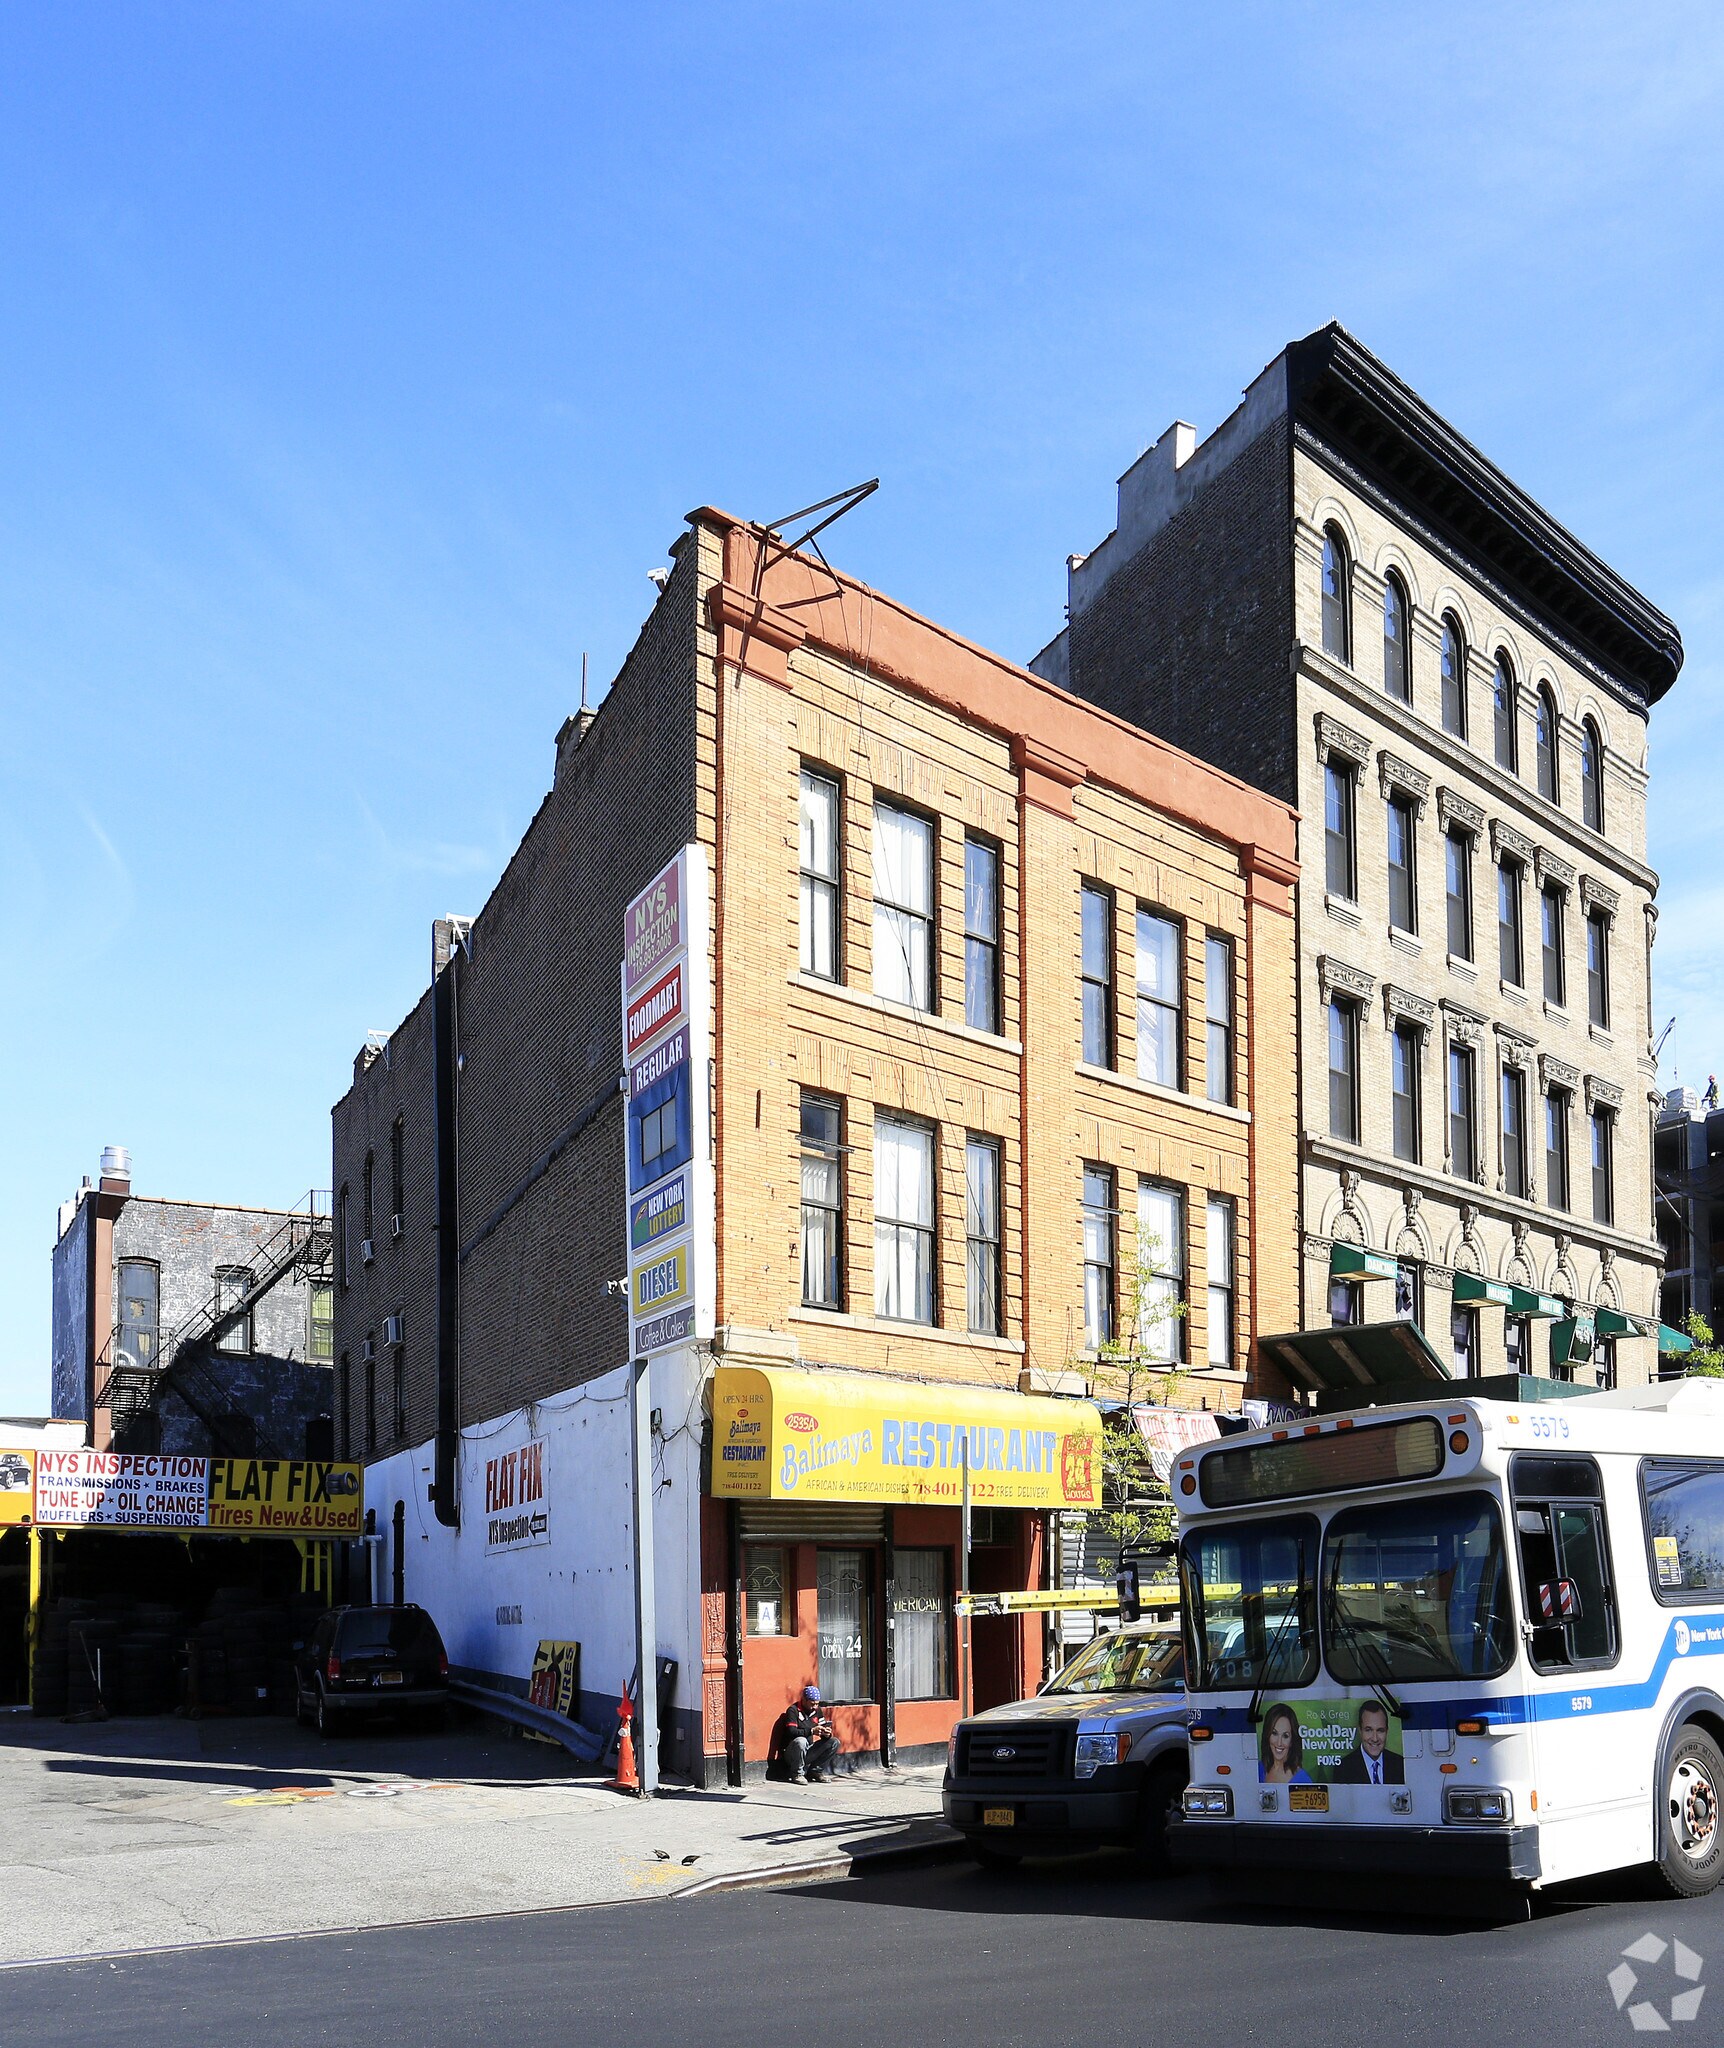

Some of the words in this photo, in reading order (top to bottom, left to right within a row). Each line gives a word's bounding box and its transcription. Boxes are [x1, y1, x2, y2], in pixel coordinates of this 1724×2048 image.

[635, 881, 667, 937] NYS
[627, 902, 678, 967] INSPECTION
[629, 976, 679, 1043] FOODMART
[636, 1035, 683, 1093] REGULAR
[648, 1194, 664, 1218] NEW
[664, 1180, 684, 1211] YORK
[649, 1205, 684, 1237] LOTTERY
[639, 1256, 680, 1307] DIESEL
[1488, 1286, 1511, 1303] MUSIC
[722, 1395, 740, 1404] OPEN
[741, 1395, 748, 1404] 24
[729, 1419, 761, 1438] Balimaya
[787, 1414, 815, 1431] 2535A
[1530, 1416, 1570, 1439] 5579
[722, 1445, 766, 1461] RESTAURANT
[780, 1428, 873, 1490] Balimaya
[882, 1419, 1056, 1473] RESTAURANT
[39, 1453, 79, 1473] NYS
[86, 1454, 207, 1478] INSPECTION
[40, 1475, 141, 1490] TRANSMISSIONS
[155, 1480, 205, 1493] BRAKES
[208, 1459, 280, 1501] FLAT
[287, 1462, 334, 1503] FIX
[485, 1451, 517, 1514] FLAT
[519, 1442, 543, 1504] FIX
[806, 1479, 838, 1491] AFRICAN
[839, 1480, 845, 1491] &
[847, 1481, 884, 1493] AMERICAN
[885, 1482, 910, 1494] DISHES
[996, 1485, 1013, 1497] FREE
[1017, 1486, 1050, 1499] DELIVERY
[40, 1490, 104, 1509] TUNE-UP
[118, 1492, 142, 1510] OIL
[146, 1494, 205, 1514] CHANGE
[1065, 1490, 1091, 1499] HOURS
[39, 1510, 104, 1522] MUFFLERS
[115, 1511, 200, 1526] SUSPENSIONS
[209, 1503, 253, 1525] Tires
[499, 1513, 529, 1545] Inspection
[762, 1606, 771, 1621] A
[823, 1636, 831, 1644] We
[1690, 1629, 1706, 1643] New
[1705, 1627, 1722, 1641] York
[821, 1643, 844, 1659] OPEN
[845, 1635, 862, 1652] 24
[557, 1646, 574, 1713] TIRES
[1306, 1710, 1318, 1720] Ro
[1320, 1710, 1327, 1720] &
[1328, 1709, 1350, 1721] Greg
[1571, 1696, 1593, 1712] 5579
[996, 1748, 1010, 1757] Ford
[1674, 1744, 1698, 1763] METRO
